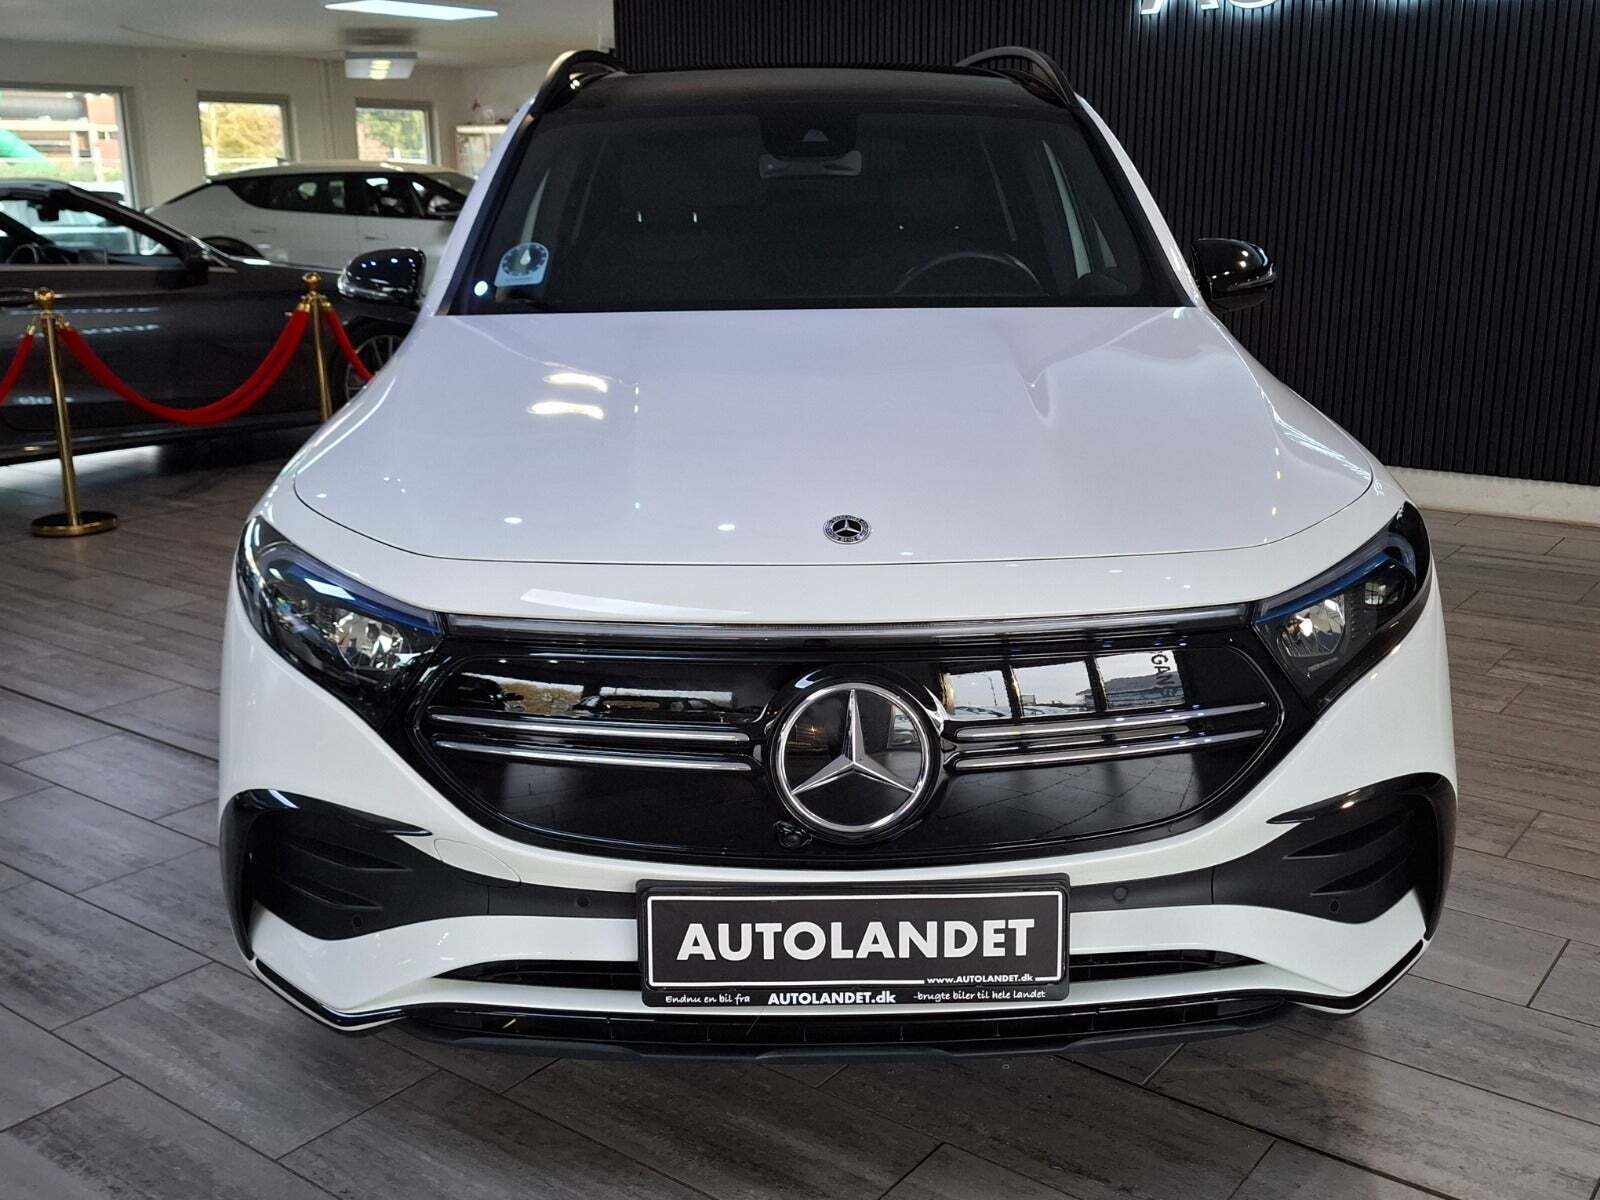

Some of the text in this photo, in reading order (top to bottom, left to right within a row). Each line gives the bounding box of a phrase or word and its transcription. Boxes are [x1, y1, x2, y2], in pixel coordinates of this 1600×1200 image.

[676, 918, 1036, 961] AUTOLANDET
[926, 973, 1034, 984] www.AUTOLANDET.dk
[665, 995, 700, 1004] Endnu
[719, 994, 732, 1003] bil
[735, 994, 750, 1005] fra
[767, 991, 896, 1005] AUTOLANDET.dk
[953, 990, 974, 1000] biler
[977, 990, 989, 999] til
[992, 990, 1011, 999] hele
[1013, 989, 1046, 999] landet
